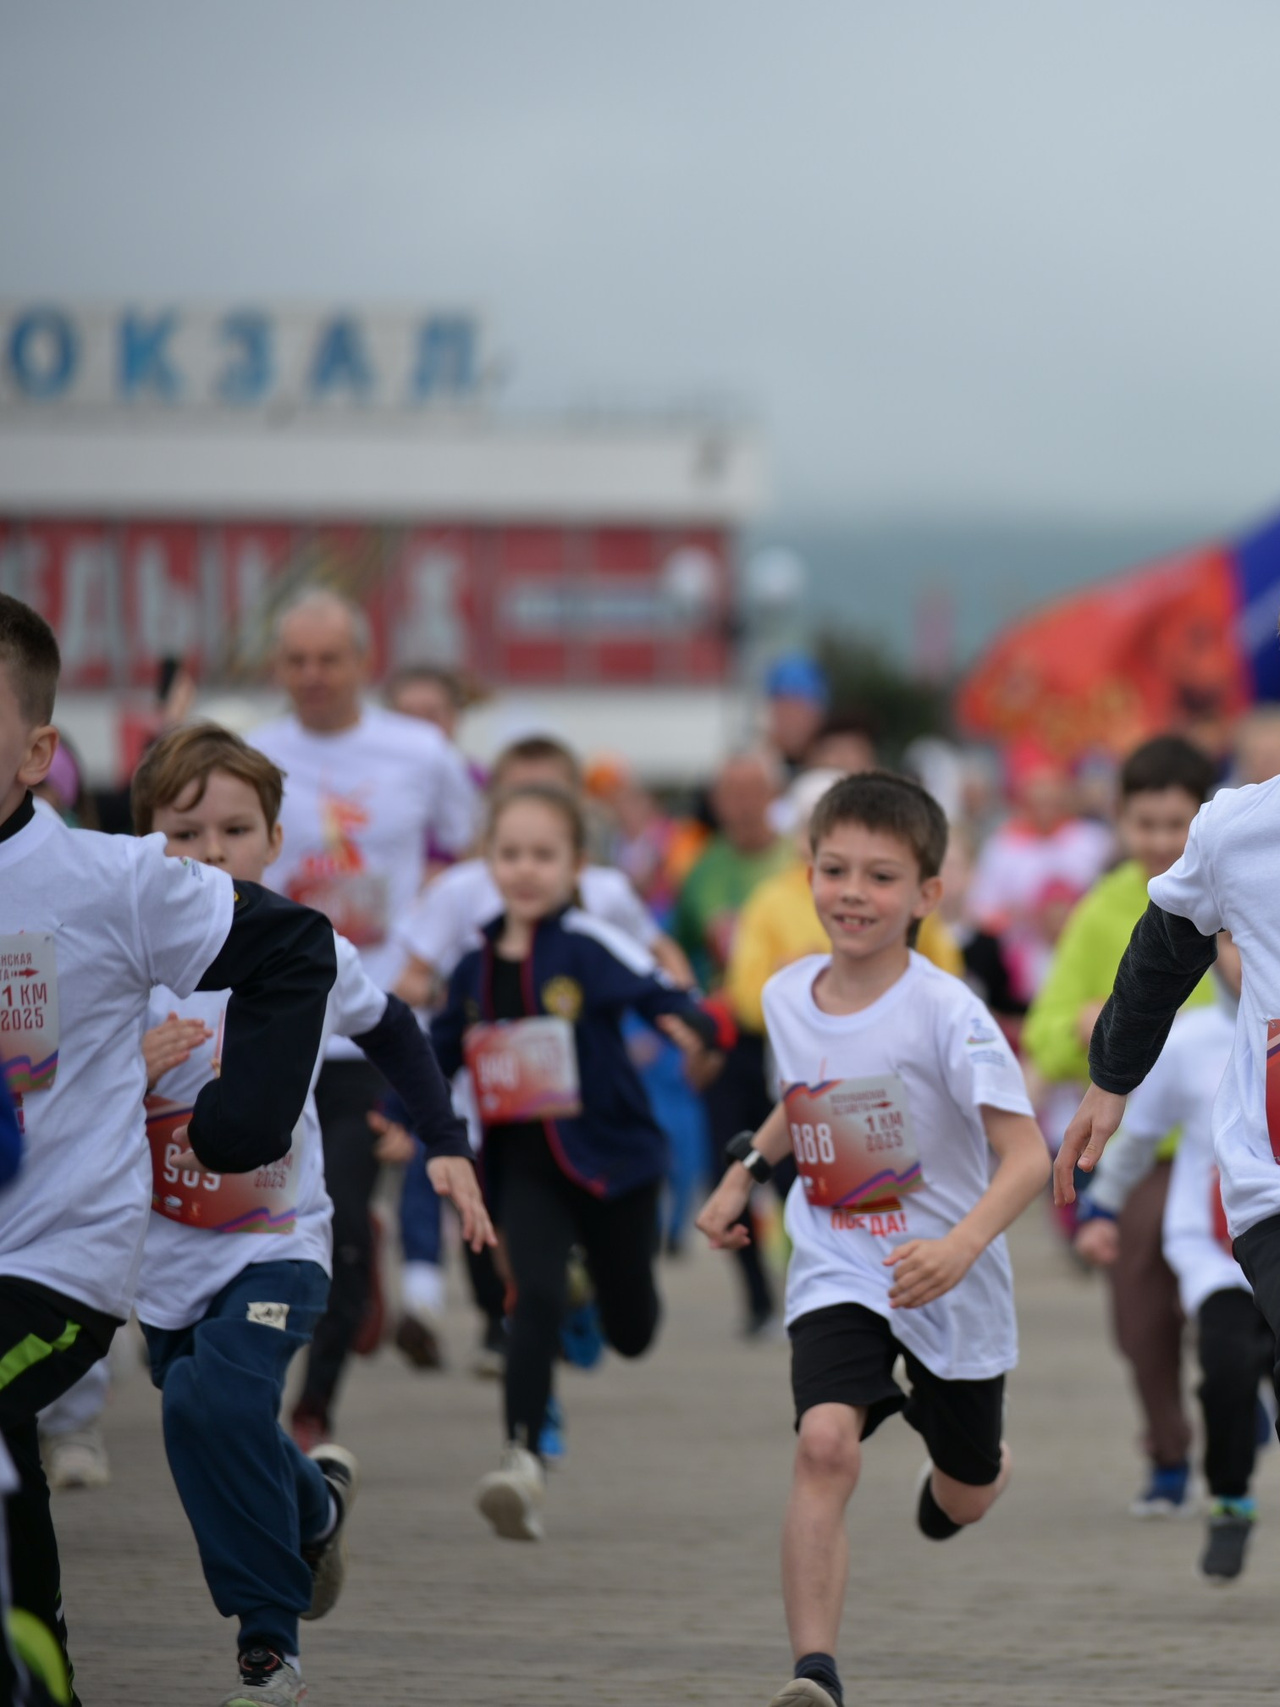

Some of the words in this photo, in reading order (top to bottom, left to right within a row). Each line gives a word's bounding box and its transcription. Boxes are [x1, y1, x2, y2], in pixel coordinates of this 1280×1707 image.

[2, 984, 13, 1007] 1
[20, 982, 47, 1006] КМ
[1, 1006, 44, 1032] 2025
[864, 1115, 876, 1132] 1
